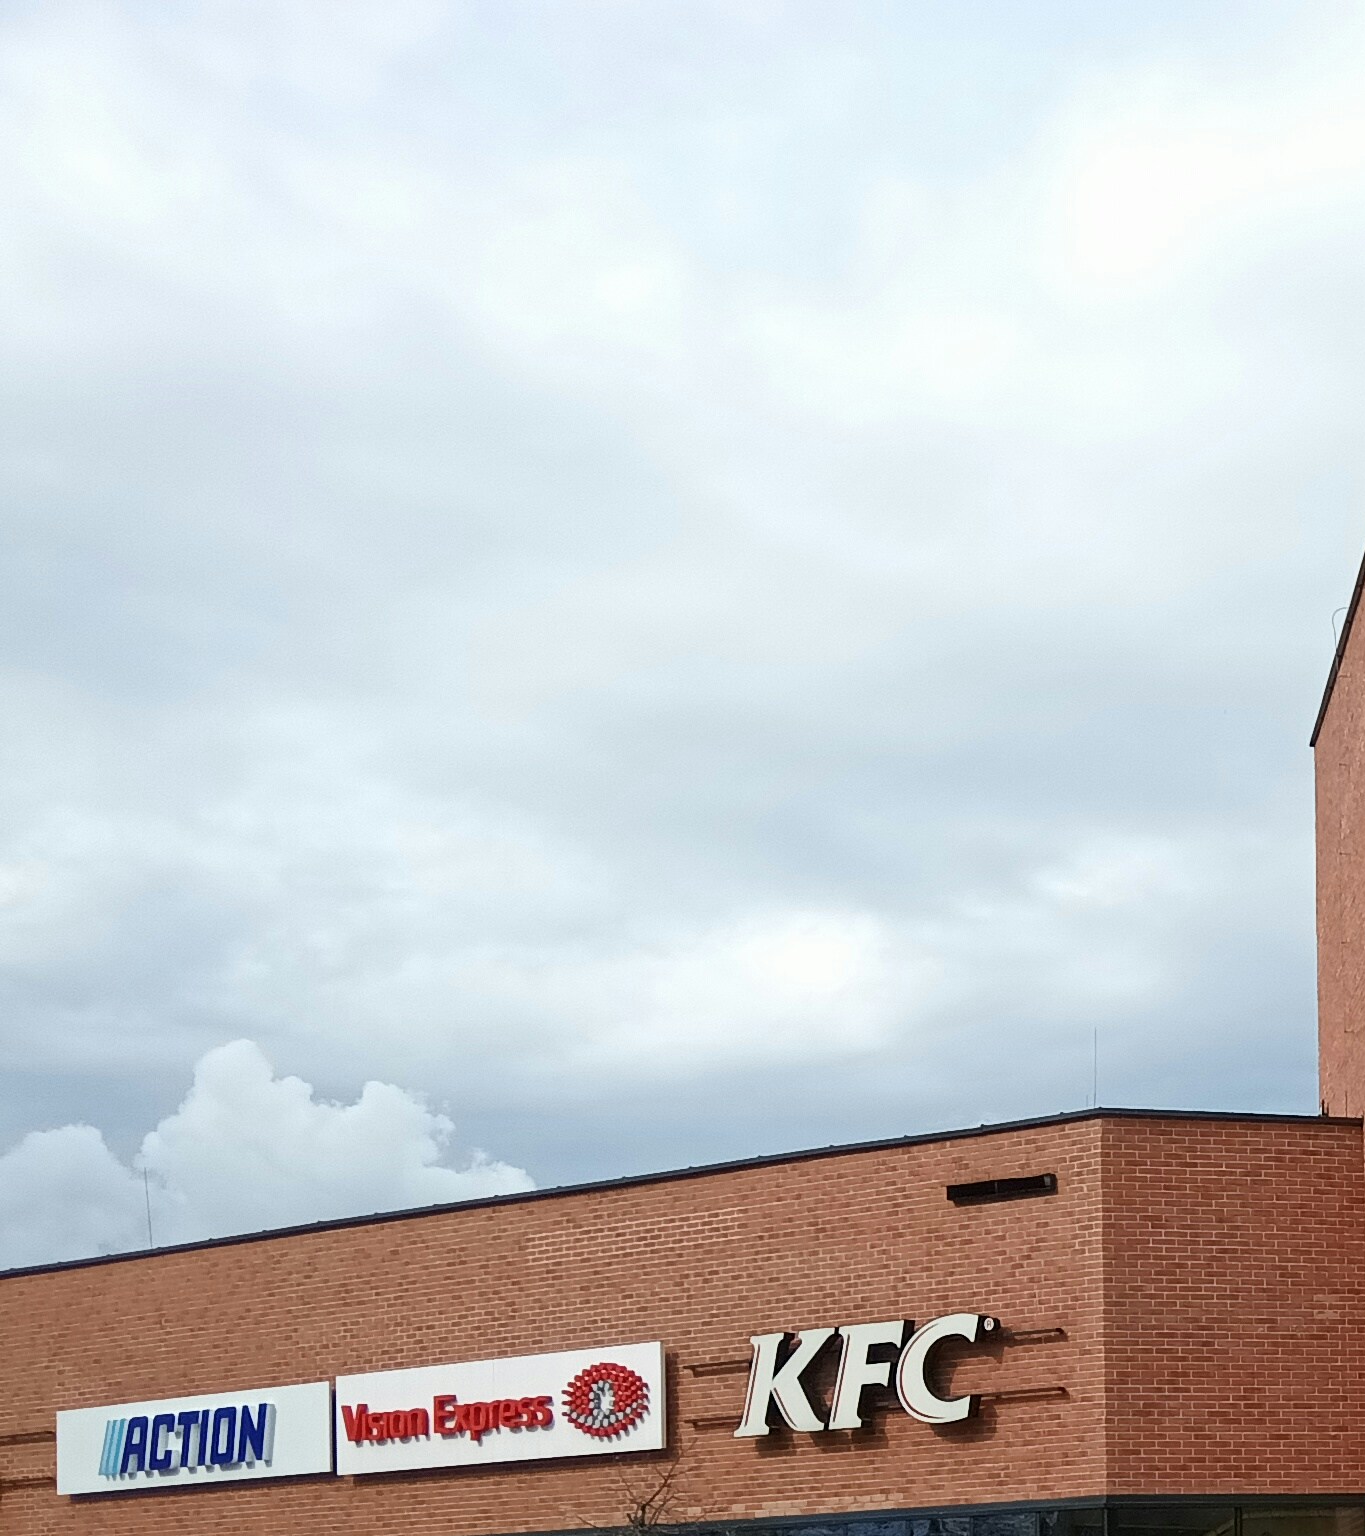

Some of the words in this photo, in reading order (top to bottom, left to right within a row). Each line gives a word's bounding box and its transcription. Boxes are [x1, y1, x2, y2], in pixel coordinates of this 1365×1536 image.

[734, 1313, 981, 1438] KFC
[120, 1402, 274, 1474] ACTION
[340, 1403, 431, 1442] Vision
[433, 1394, 555, 1441] Express
